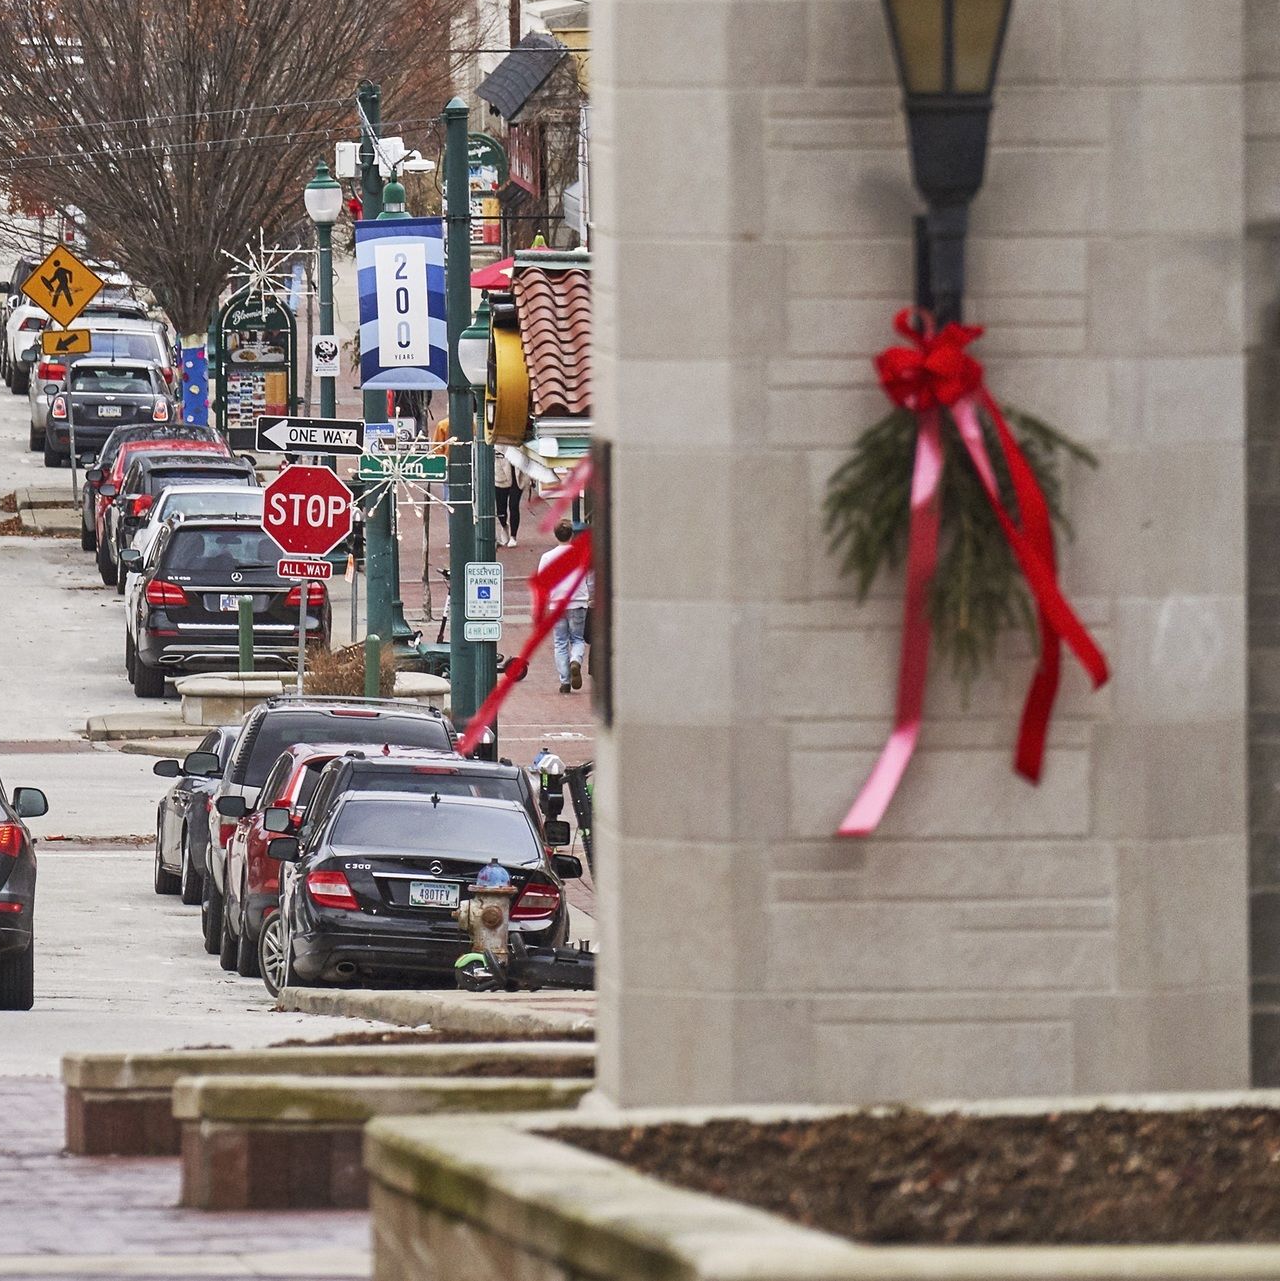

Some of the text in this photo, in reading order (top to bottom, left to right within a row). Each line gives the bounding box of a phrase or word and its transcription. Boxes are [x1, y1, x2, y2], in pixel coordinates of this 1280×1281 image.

[394, 252, 411, 349] 200
[394, 353, 415, 361] YEARS
[290, 428, 317, 443] ONE
[323, 429, 353, 444] WAY
[268, 493, 347, 527] STOP
[282, 563, 328, 576] ALL WAY
[468, 568, 500, 576] RESERVED
[474, 626, 481, 635] HR
[483, 626, 498, 635] LIMIT
